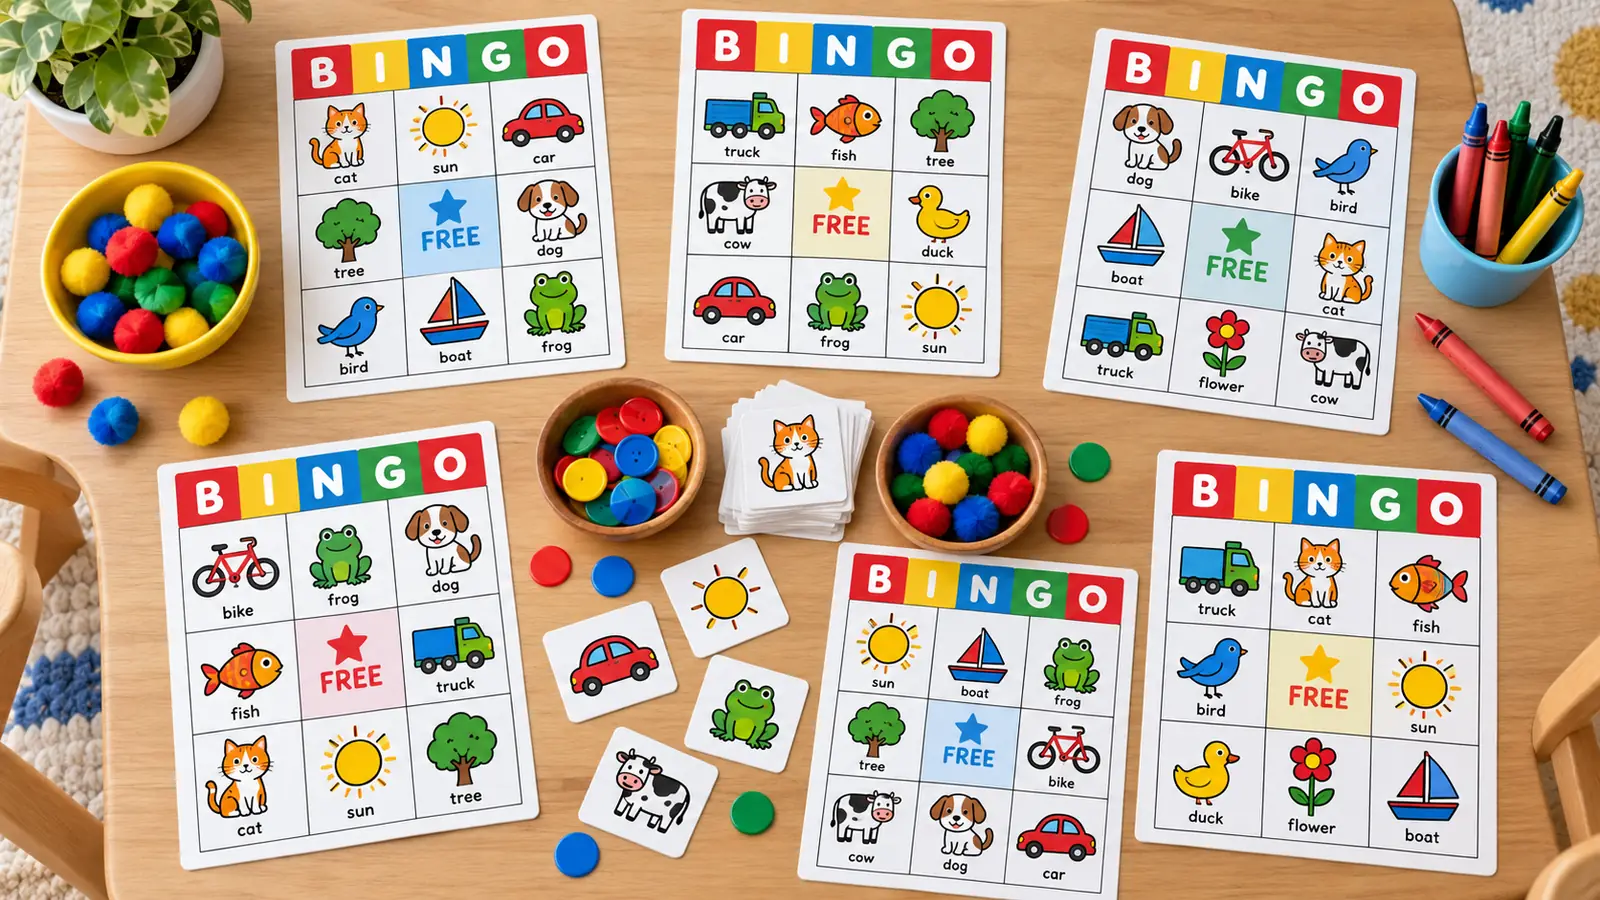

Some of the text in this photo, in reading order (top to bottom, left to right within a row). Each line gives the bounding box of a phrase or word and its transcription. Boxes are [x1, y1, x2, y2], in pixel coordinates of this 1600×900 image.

[714, 29, 976, 72] BINGO
[310, 36, 570, 89] BINGO
[1125, 51, 1385, 115] BINGO
[532, 153, 556, 165] car
[724, 146, 761, 158] truck
[830, 148, 857, 162] fish
[433, 163, 459, 175] sun
[925, 155, 955, 168] tree
[333, 171, 358, 185] cat
[1126, 171, 1154, 190] dog
[1230, 185, 1260, 202] bike
[1329, 198, 1358, 215] bird
[812, 213, 871, 236] FREE
[421, 225, 481, 252] FREE
[723, 240, 752, 250] cow
[536, 244, 563, 259] dog
[921, 244, 954, 259] duck
[333, 267, 365, 279] tree
[1206, 255, 1269, 283] FREE
[1111, 270, 1144, 286] boat
[1322, 305, 1346, 317] cat
[541, 340, 572, 354] frog
[721, 334, 746, 344] car
[820, 335, 850, 352] frog
[439, 349, 472, 364] boat
[922, 344, 947, 354] sun
[339, 359, 369, 376] bird
[1096, 364, 1134, 379] truck
[1198, 375, 1245, 393] flower
[1310, 394, 1339, 406] cow
[195, 447, 467, 516] BINGO
[1192, 473, 1463, 526] BINGO
[431, 579, 460, 595] dog
[867, 564, 1108, 614] BINGO
[327, 593, 359, 607] frog
[222, 604, 254, 620] bike
[1197, 603, 1236, 617] truck
[1307, 614, 1332, 626] cat
[1412, 618, 1440, 634] fish
[320, 664, 383, 694] FREE
[436, 676, 476, 694] truck
[871, 678, 895, 689] sun
[960, 685, 990, 699] boat
[1289, 685, 1349, 710] FREE
[1054, 694, 1081, 711] frog
[1196, 702, 1226, 718] bird
[230, 704, 260, 721] fish
[1410, 723, 1437, 735] sun
[943, 745, 996, 768] FREE
[859, 759, 886, 772] tree
[1048, 775, 1075, 789] bike
[449, 791, 482, 805] tree
[347, 806, 375, 819] sun
[1188, 809, 1224, 825] duck
[237, 821, 263, 837] cat
[1287, 817, 1337, 835] flower
[1405, 827, 1440, 844] boat
[848, 853, 875, 864] cow
[942, 858, 968, 875] dog
[1042, 870, 1066, 881] car
